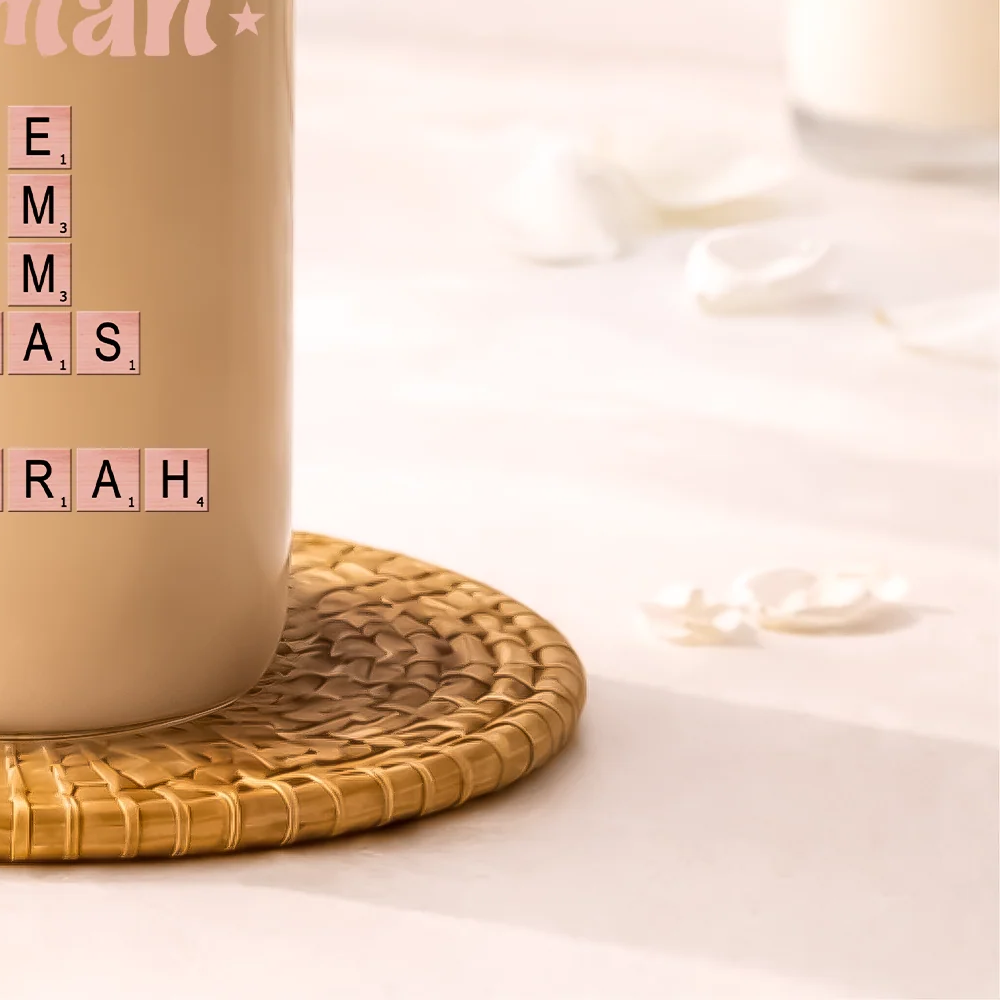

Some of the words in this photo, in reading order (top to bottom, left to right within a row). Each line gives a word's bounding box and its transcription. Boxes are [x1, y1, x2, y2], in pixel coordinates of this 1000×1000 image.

[60, 155, 67, 165] 1
[60, 223, 67, 233] 3
[22, 116, 55, 362] EMMA
[60, 291, 67, 301] 3
[60, 360, 66, 370] 1
[129, 360, 136, 370] 1
[61, 497, 67, 507] 1
[128, 497, 135, 507] 1
[197, 497, 204, 507] 4
